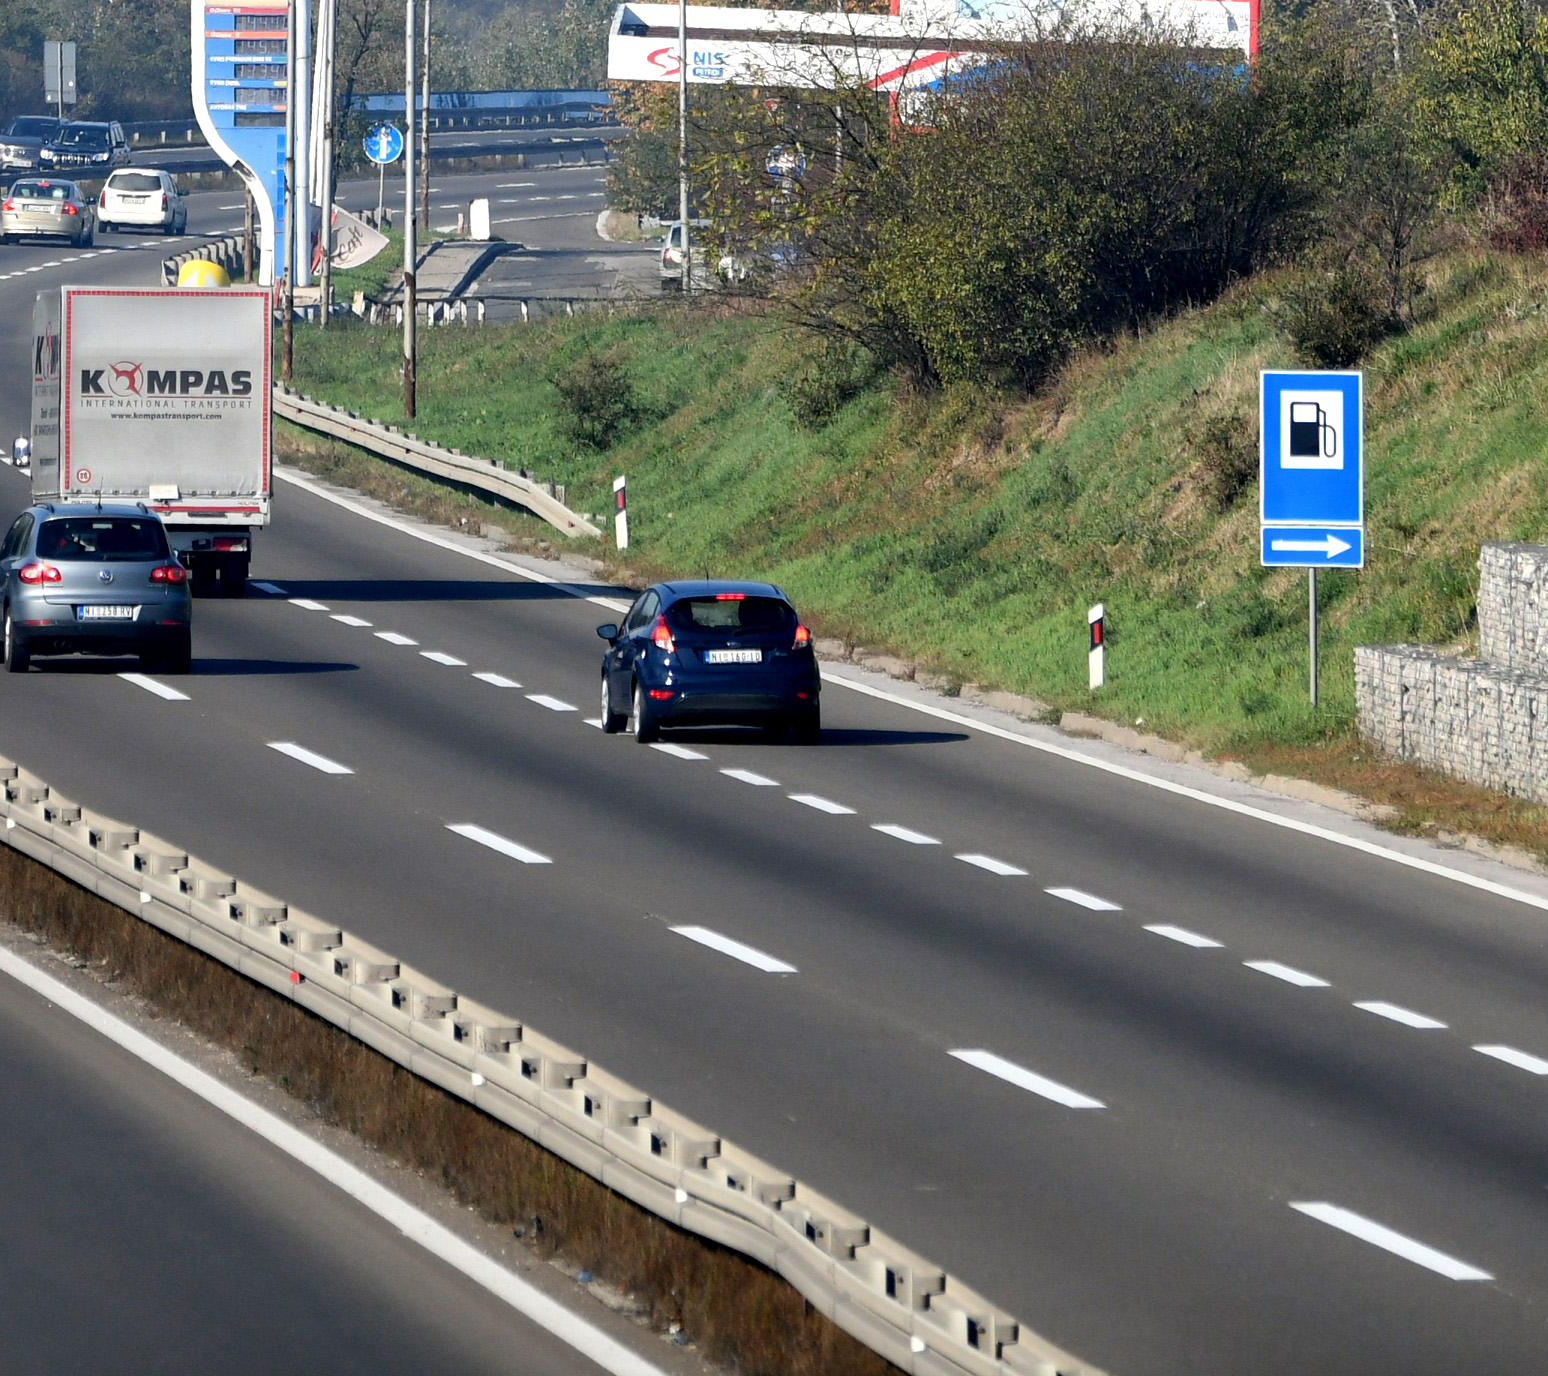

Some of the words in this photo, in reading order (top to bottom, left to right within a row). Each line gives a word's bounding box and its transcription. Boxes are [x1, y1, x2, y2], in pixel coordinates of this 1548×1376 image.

[694, 51, 724, 65] NIS
[81, 361, 252, 397] KOMPAS
[81, 400, 176, 408] INTERNATIONAL
[184, 400, 252, 409] TRANSPORT
[111, 411, 222, 421] www.kompastransport.com
